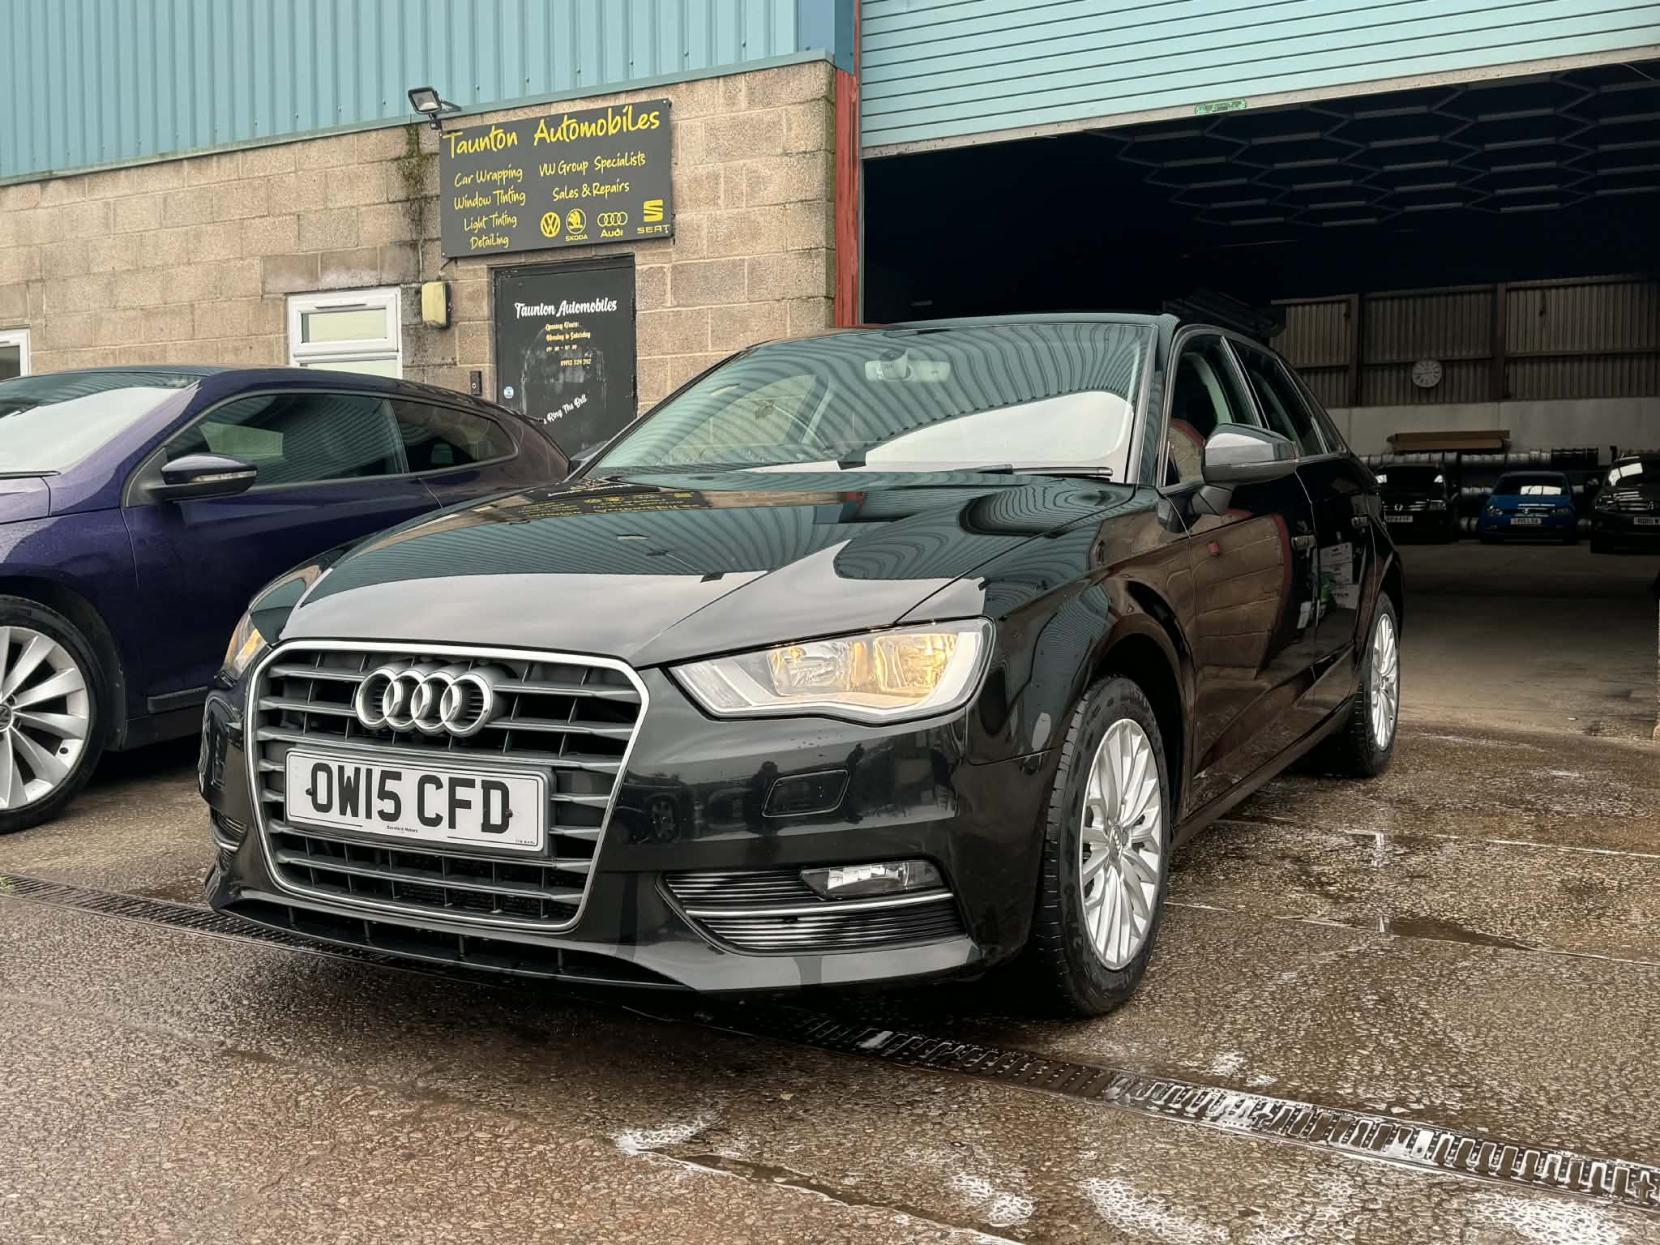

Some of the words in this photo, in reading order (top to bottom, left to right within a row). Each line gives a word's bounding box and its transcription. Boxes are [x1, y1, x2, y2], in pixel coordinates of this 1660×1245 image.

[443, 125, 518, 159] Taunton
[533, 105, 660, 146] Automobiles
[454, 171, 473, 187] Car
[476, 163, 523, 185] Wrapping
[539, 164, 557, 177] VW
[558, 159, 589, 175] Group
[594, 150, 646, 171] Specialists
[454, 194, 492, 210] Window
[493, 185, 526, 206] Tinting
[552, 187, 579, 202] Sales
[581, 184, 592, 198] &
[592, 178, 630, 198] Repairs
[464, 216, 489, 234] Light
[490, 209, 517, 227] Tinting
[600, 228, 624, 238] Audi
[637, 224, 670, 234] SEAT
[469, 233, 509, 249] Detailing
[514, 302, 556, 319] Taunton
[556, 297, 618, 317] Automobiles
[311, 762, 402, 822] OW15
[417, 774, 510, 834] CFD
